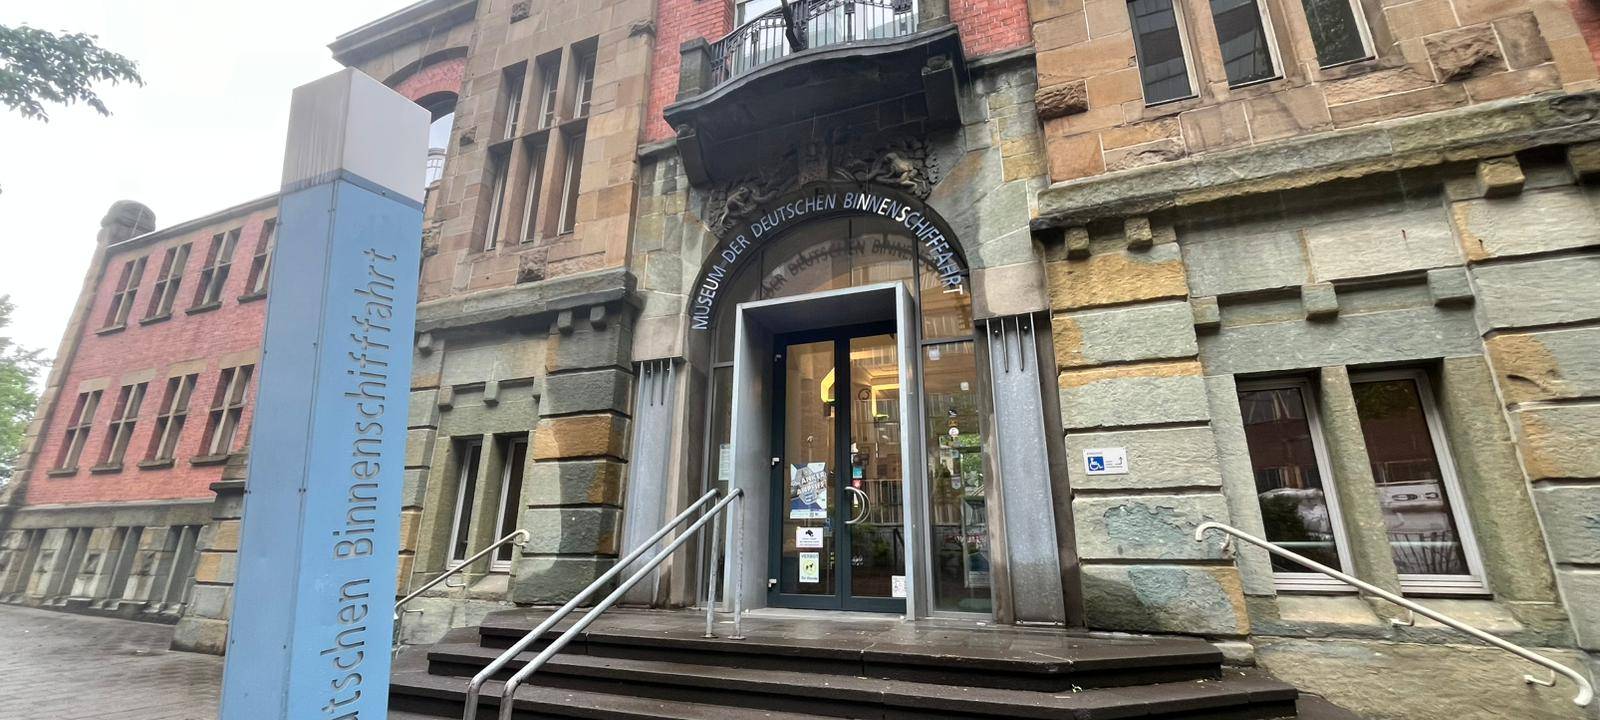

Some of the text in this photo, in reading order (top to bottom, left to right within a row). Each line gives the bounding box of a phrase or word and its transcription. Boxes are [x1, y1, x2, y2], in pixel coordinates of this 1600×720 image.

[692, 264, 727, 330] MUSEUM
[721, 234, 751, 264] DER
[750, 193, 837, 239] DEUTSCHEN
[843, 191, 964, 295] BINNENSCHIFFFAHRT
[332, 248, 397, 560] Binnenschifffahrt
